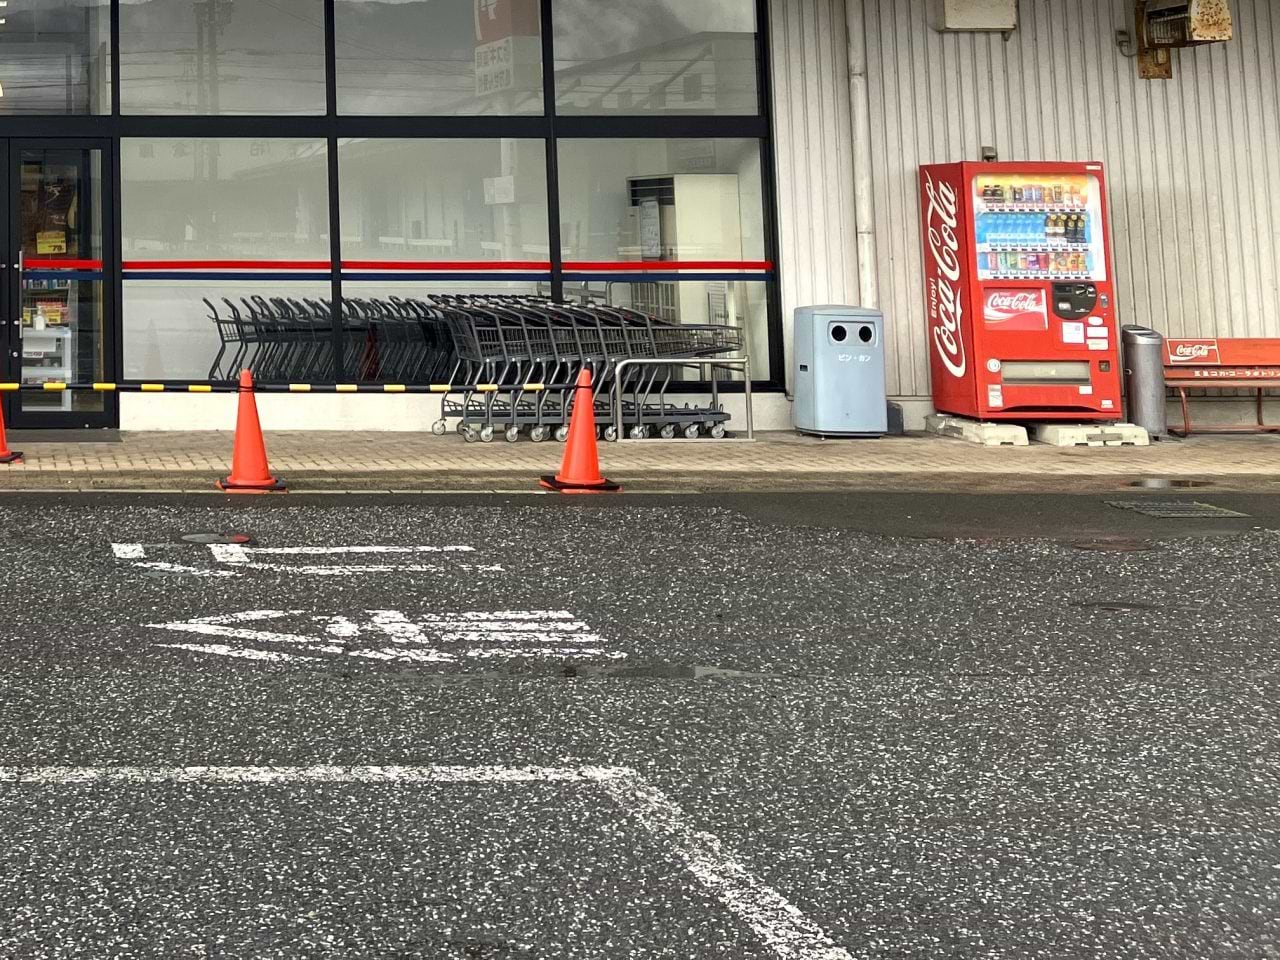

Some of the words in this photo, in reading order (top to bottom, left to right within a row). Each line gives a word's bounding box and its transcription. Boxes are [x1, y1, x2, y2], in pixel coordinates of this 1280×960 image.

[925, 169, 966, 378] Coca-Cola
[987, 292, 1036, 310] Coca-Cola
[838, 354, 872, 362] ビン・カン
